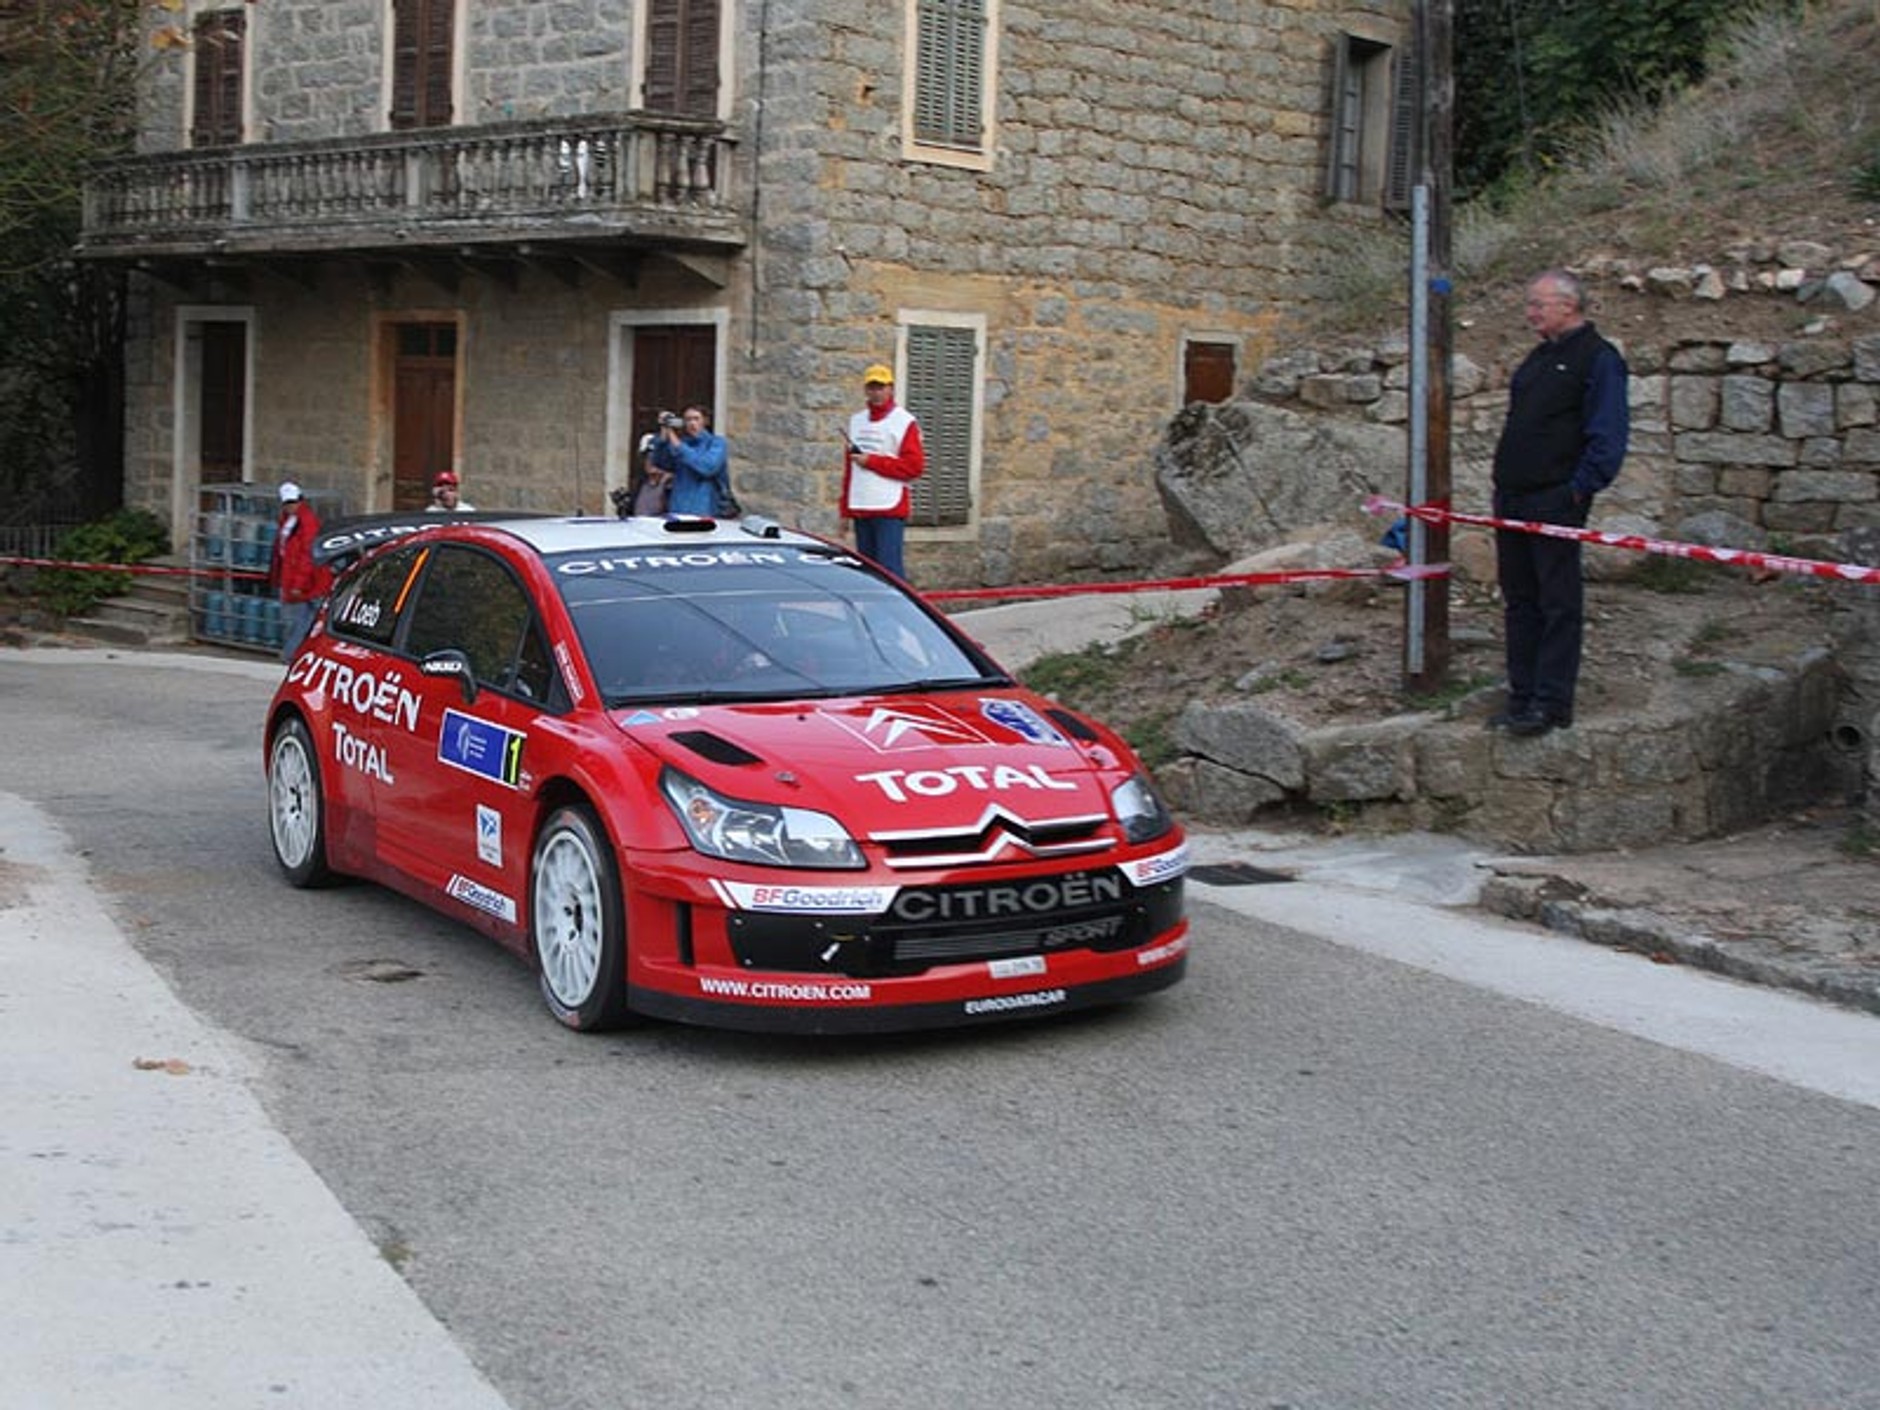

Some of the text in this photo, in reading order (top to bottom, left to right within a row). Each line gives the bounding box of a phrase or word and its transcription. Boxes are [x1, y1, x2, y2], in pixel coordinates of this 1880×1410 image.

[558, 551, 786, 575] CITROËN
[287, 651, 422, 733] CITROËN
[332, 721, 395, 785] TOTAL
[510, 735, 521, 785] 1
[854, 764, 1079, 803] TOTAL
[752, 887, 883, 907] BFGoodrich
[894, 871, 1122, 921] CITROËN
[700, 976, 872, 1000] WWW.CITROEN.COM
